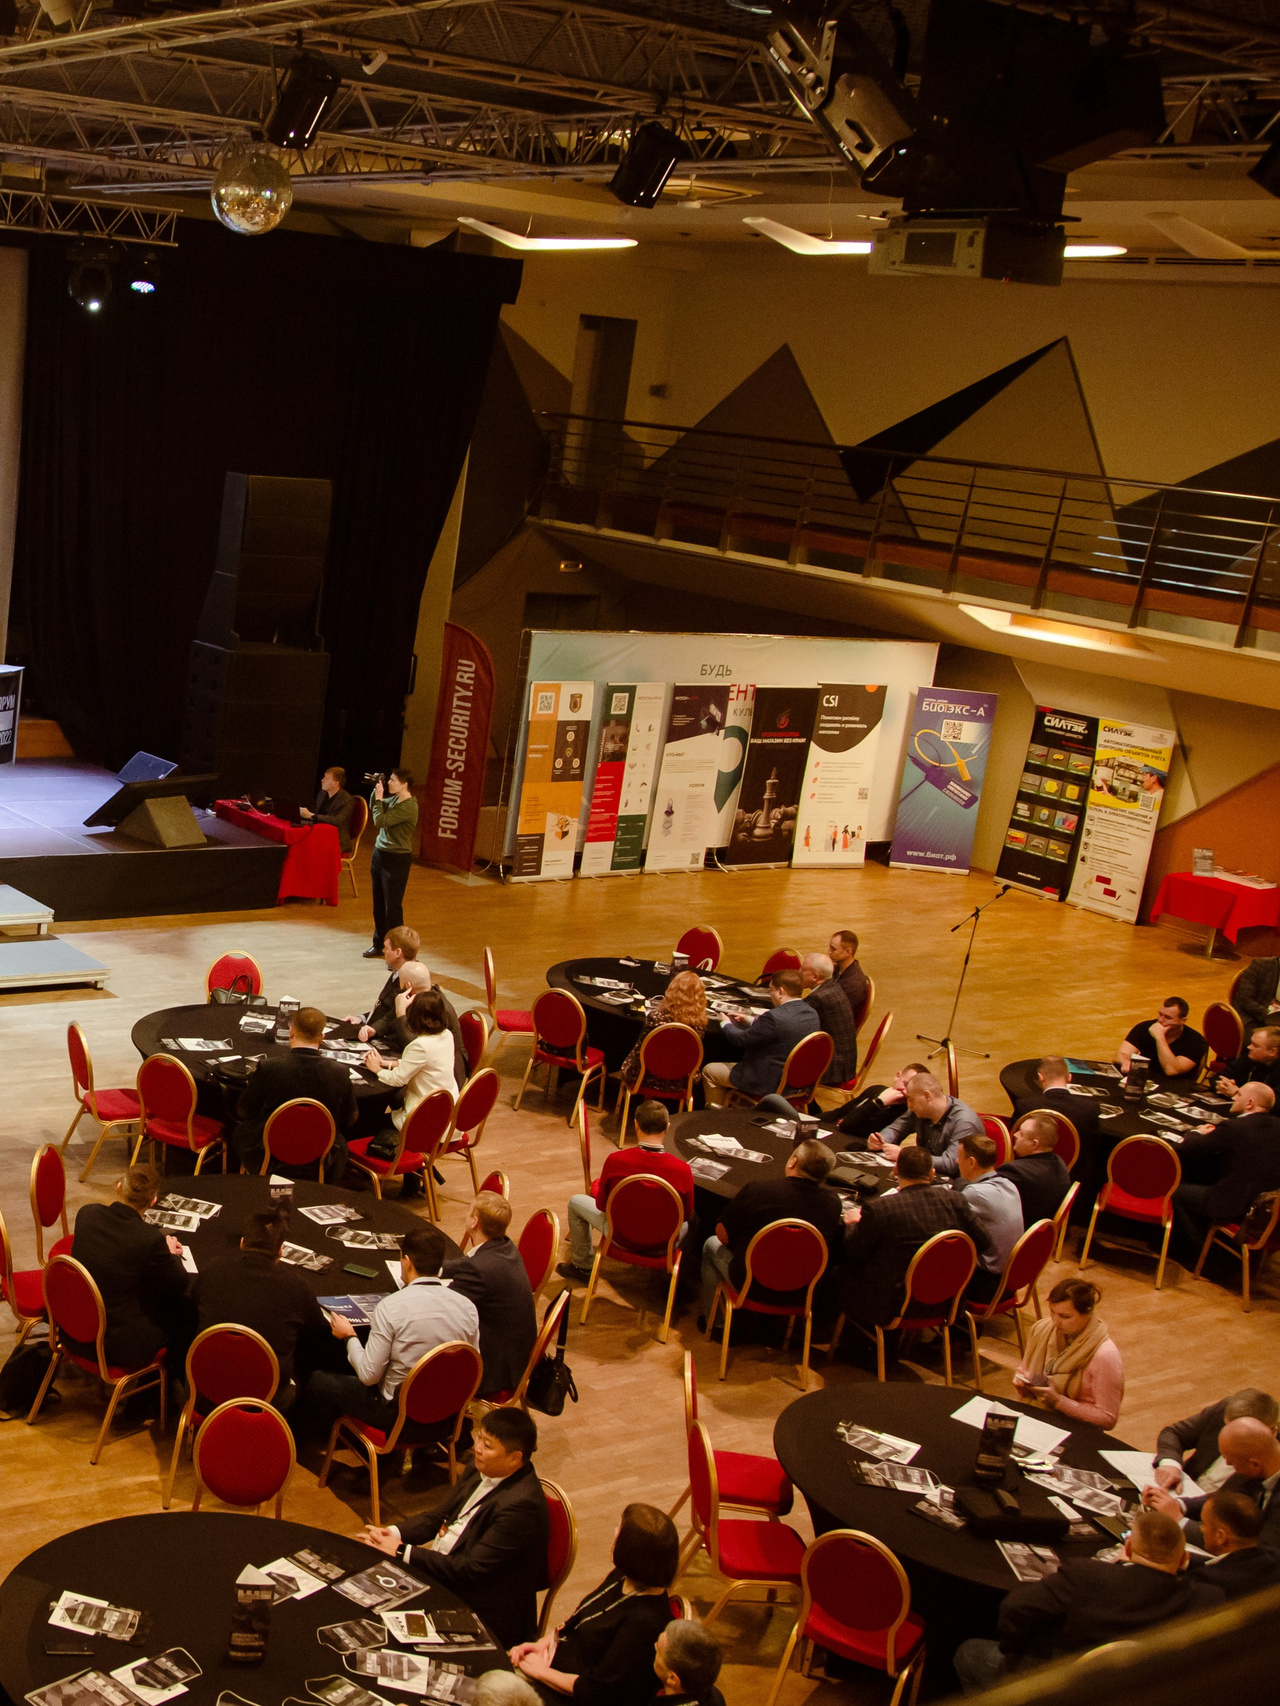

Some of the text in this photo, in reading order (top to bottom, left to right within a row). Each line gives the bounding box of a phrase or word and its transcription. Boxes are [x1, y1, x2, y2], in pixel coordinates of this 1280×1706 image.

[700, 664, 732, 678] БУДЬ
[822, 695, 839, 707] CSI
[438, 659, 476, 840] FORUM-SECURITY.RU
